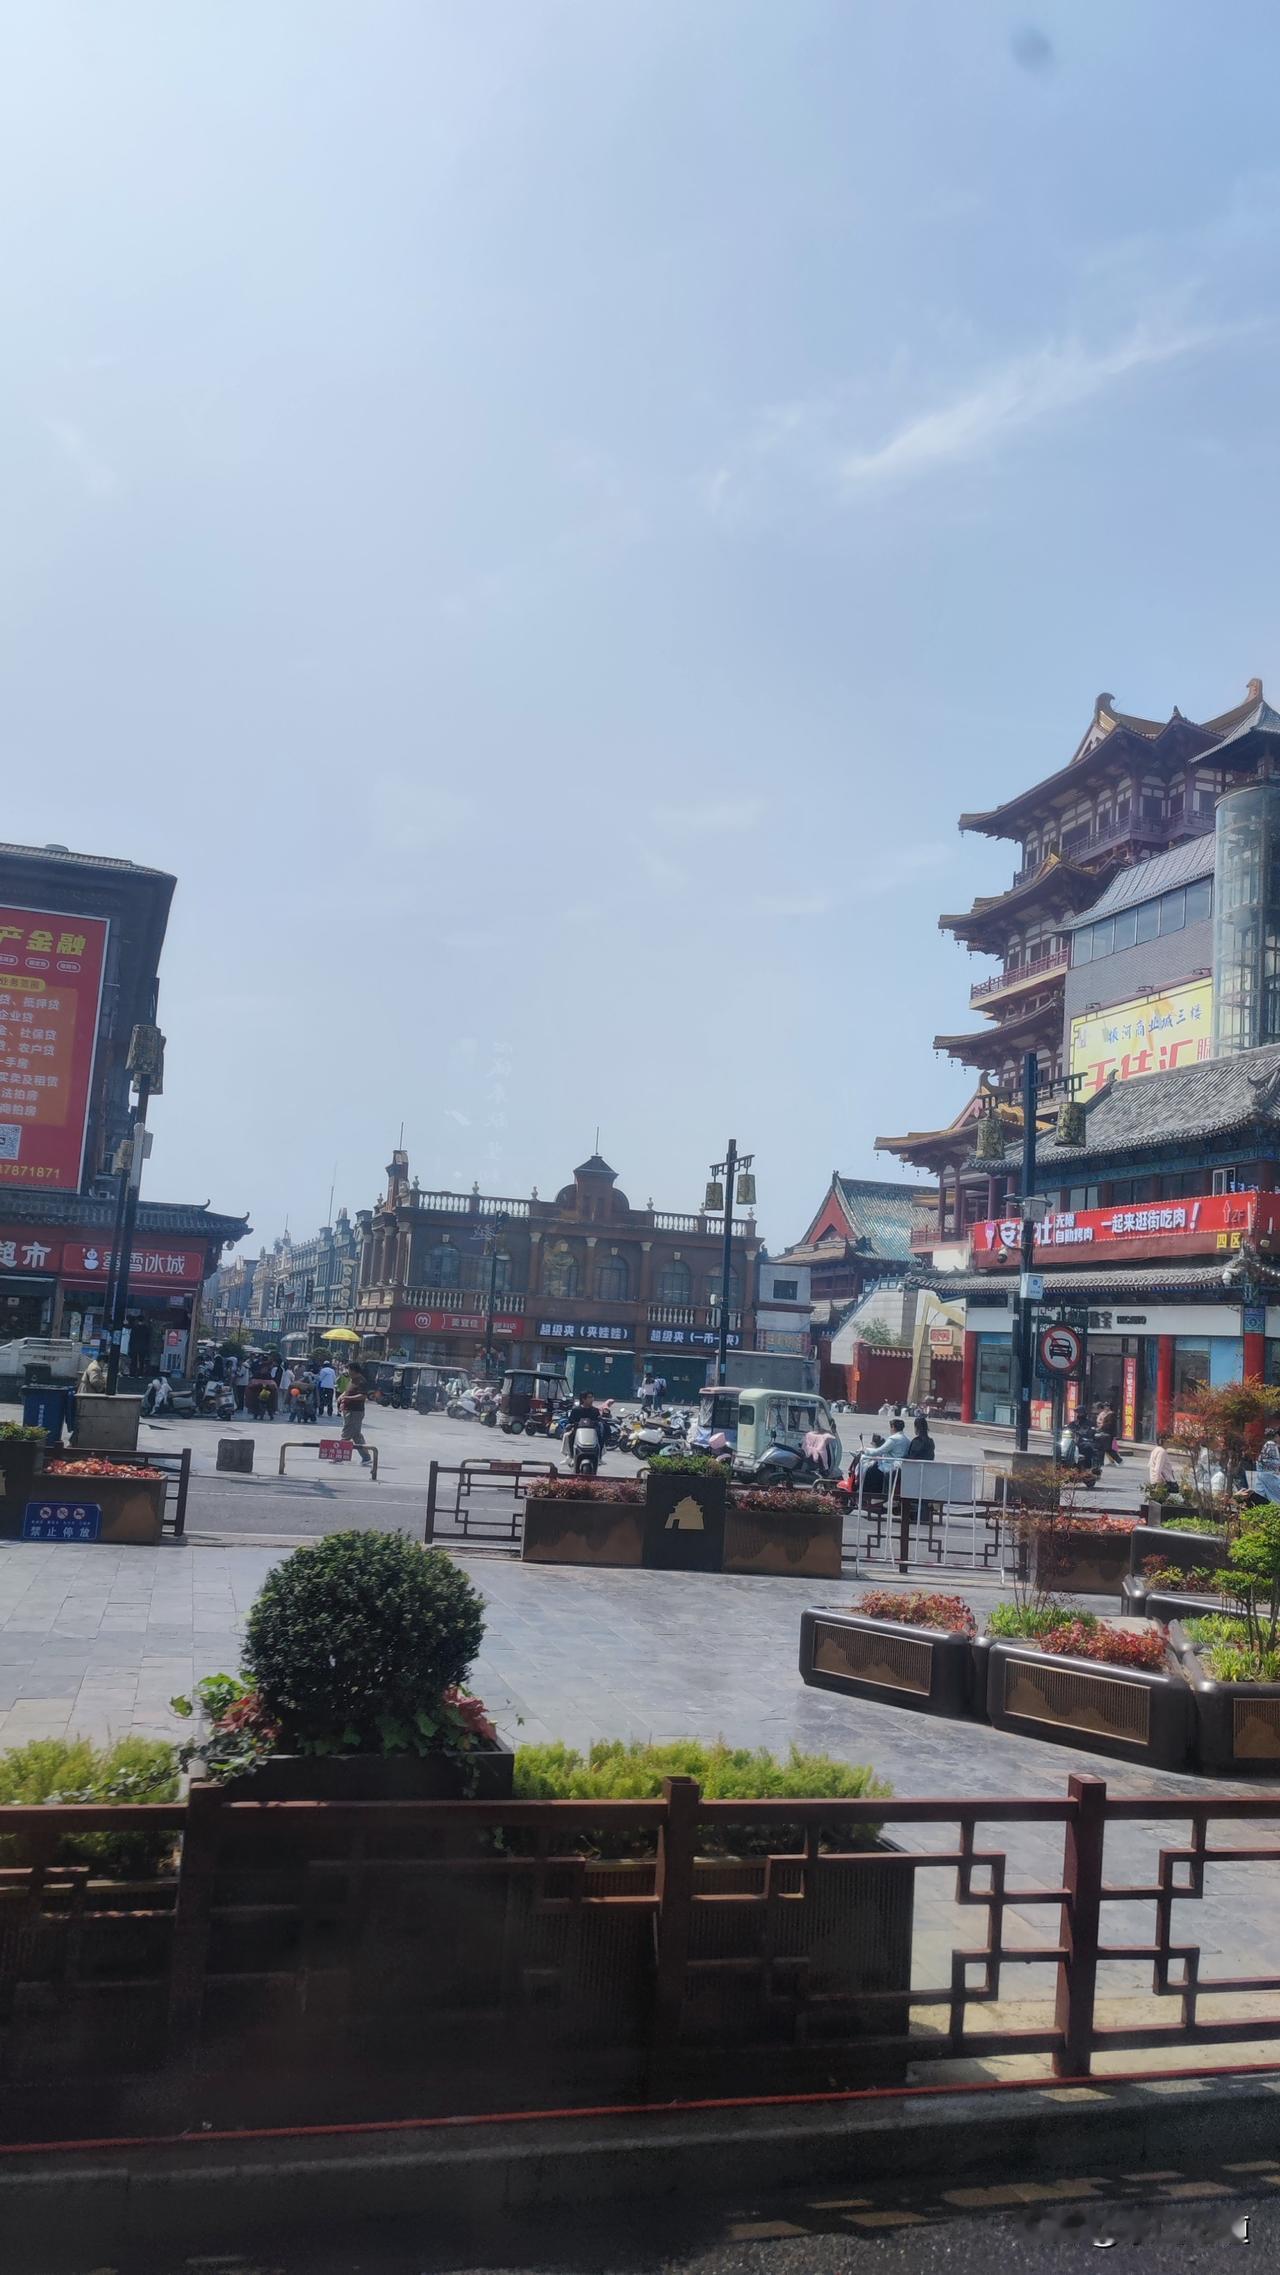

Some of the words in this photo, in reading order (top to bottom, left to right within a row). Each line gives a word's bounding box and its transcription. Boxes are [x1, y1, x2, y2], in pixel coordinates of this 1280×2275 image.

[1232, 1209, 1246, 1223] 2F
[1216, 1232, 1241, 1249] 四区
[30, 1525, 91, 1538] 禁止停放
